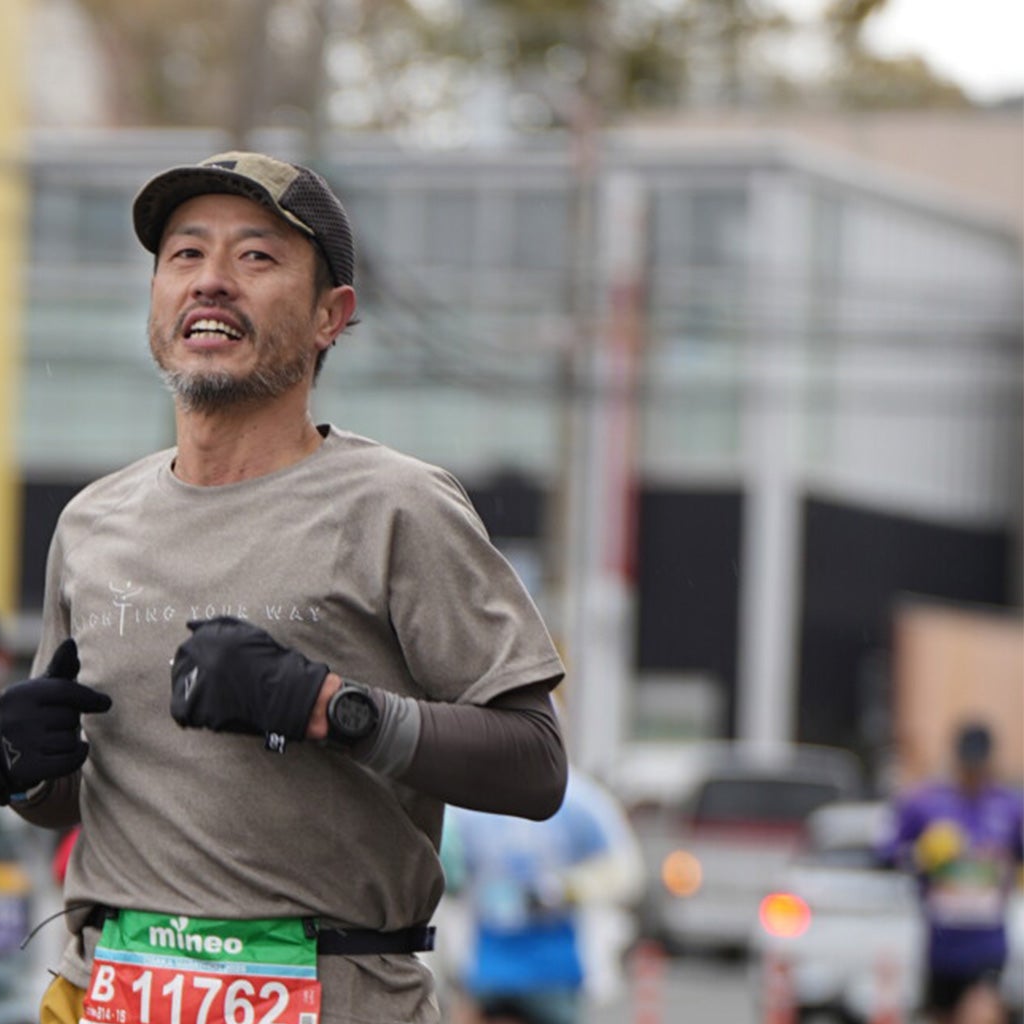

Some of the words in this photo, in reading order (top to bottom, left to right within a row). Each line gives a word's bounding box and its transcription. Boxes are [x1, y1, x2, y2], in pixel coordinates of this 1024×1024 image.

[265, 604, 321, 622] WAY
[149, 916, 243, 954] mineo
[91, 965, 116, 1002] B
